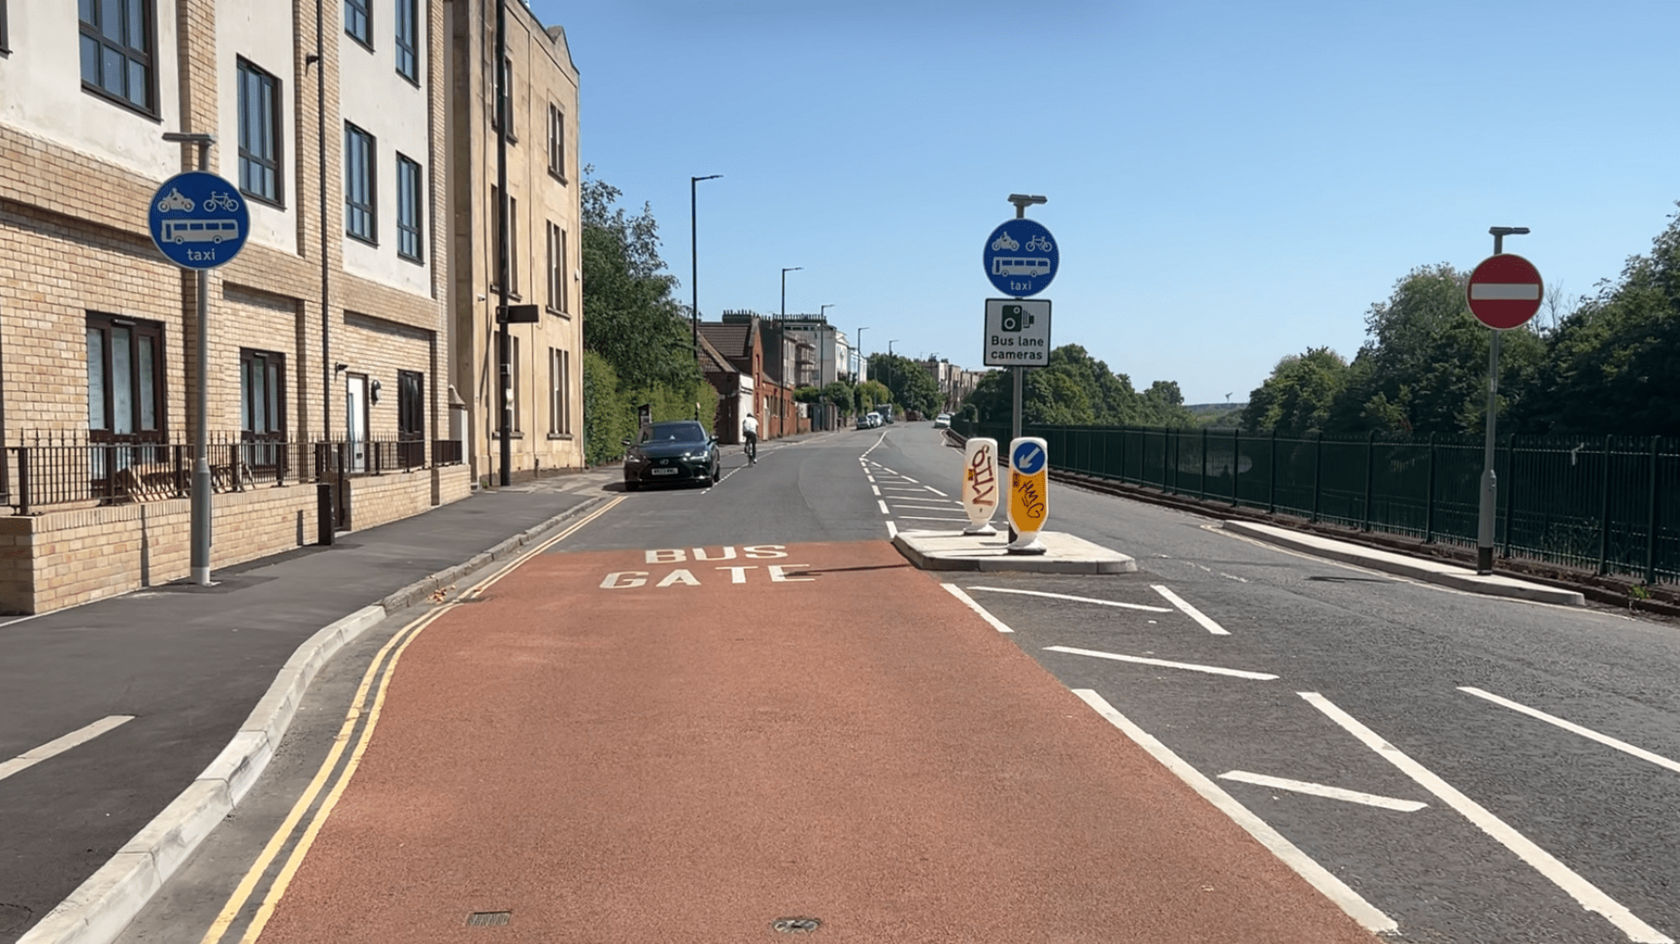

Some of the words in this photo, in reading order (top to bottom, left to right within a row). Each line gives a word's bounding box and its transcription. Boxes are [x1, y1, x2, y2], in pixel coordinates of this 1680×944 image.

[186, 248, 216, 261] taxi
[1010, 280, 1032, 291] taxi
[991, 335, 1014, 347] Bus
[1018, 335, 1044, 347] lane
[991, 350, 1043, 360] cameras
[645, 544, 789, 564] BUS
[599, 563, 816, 589] GATE
